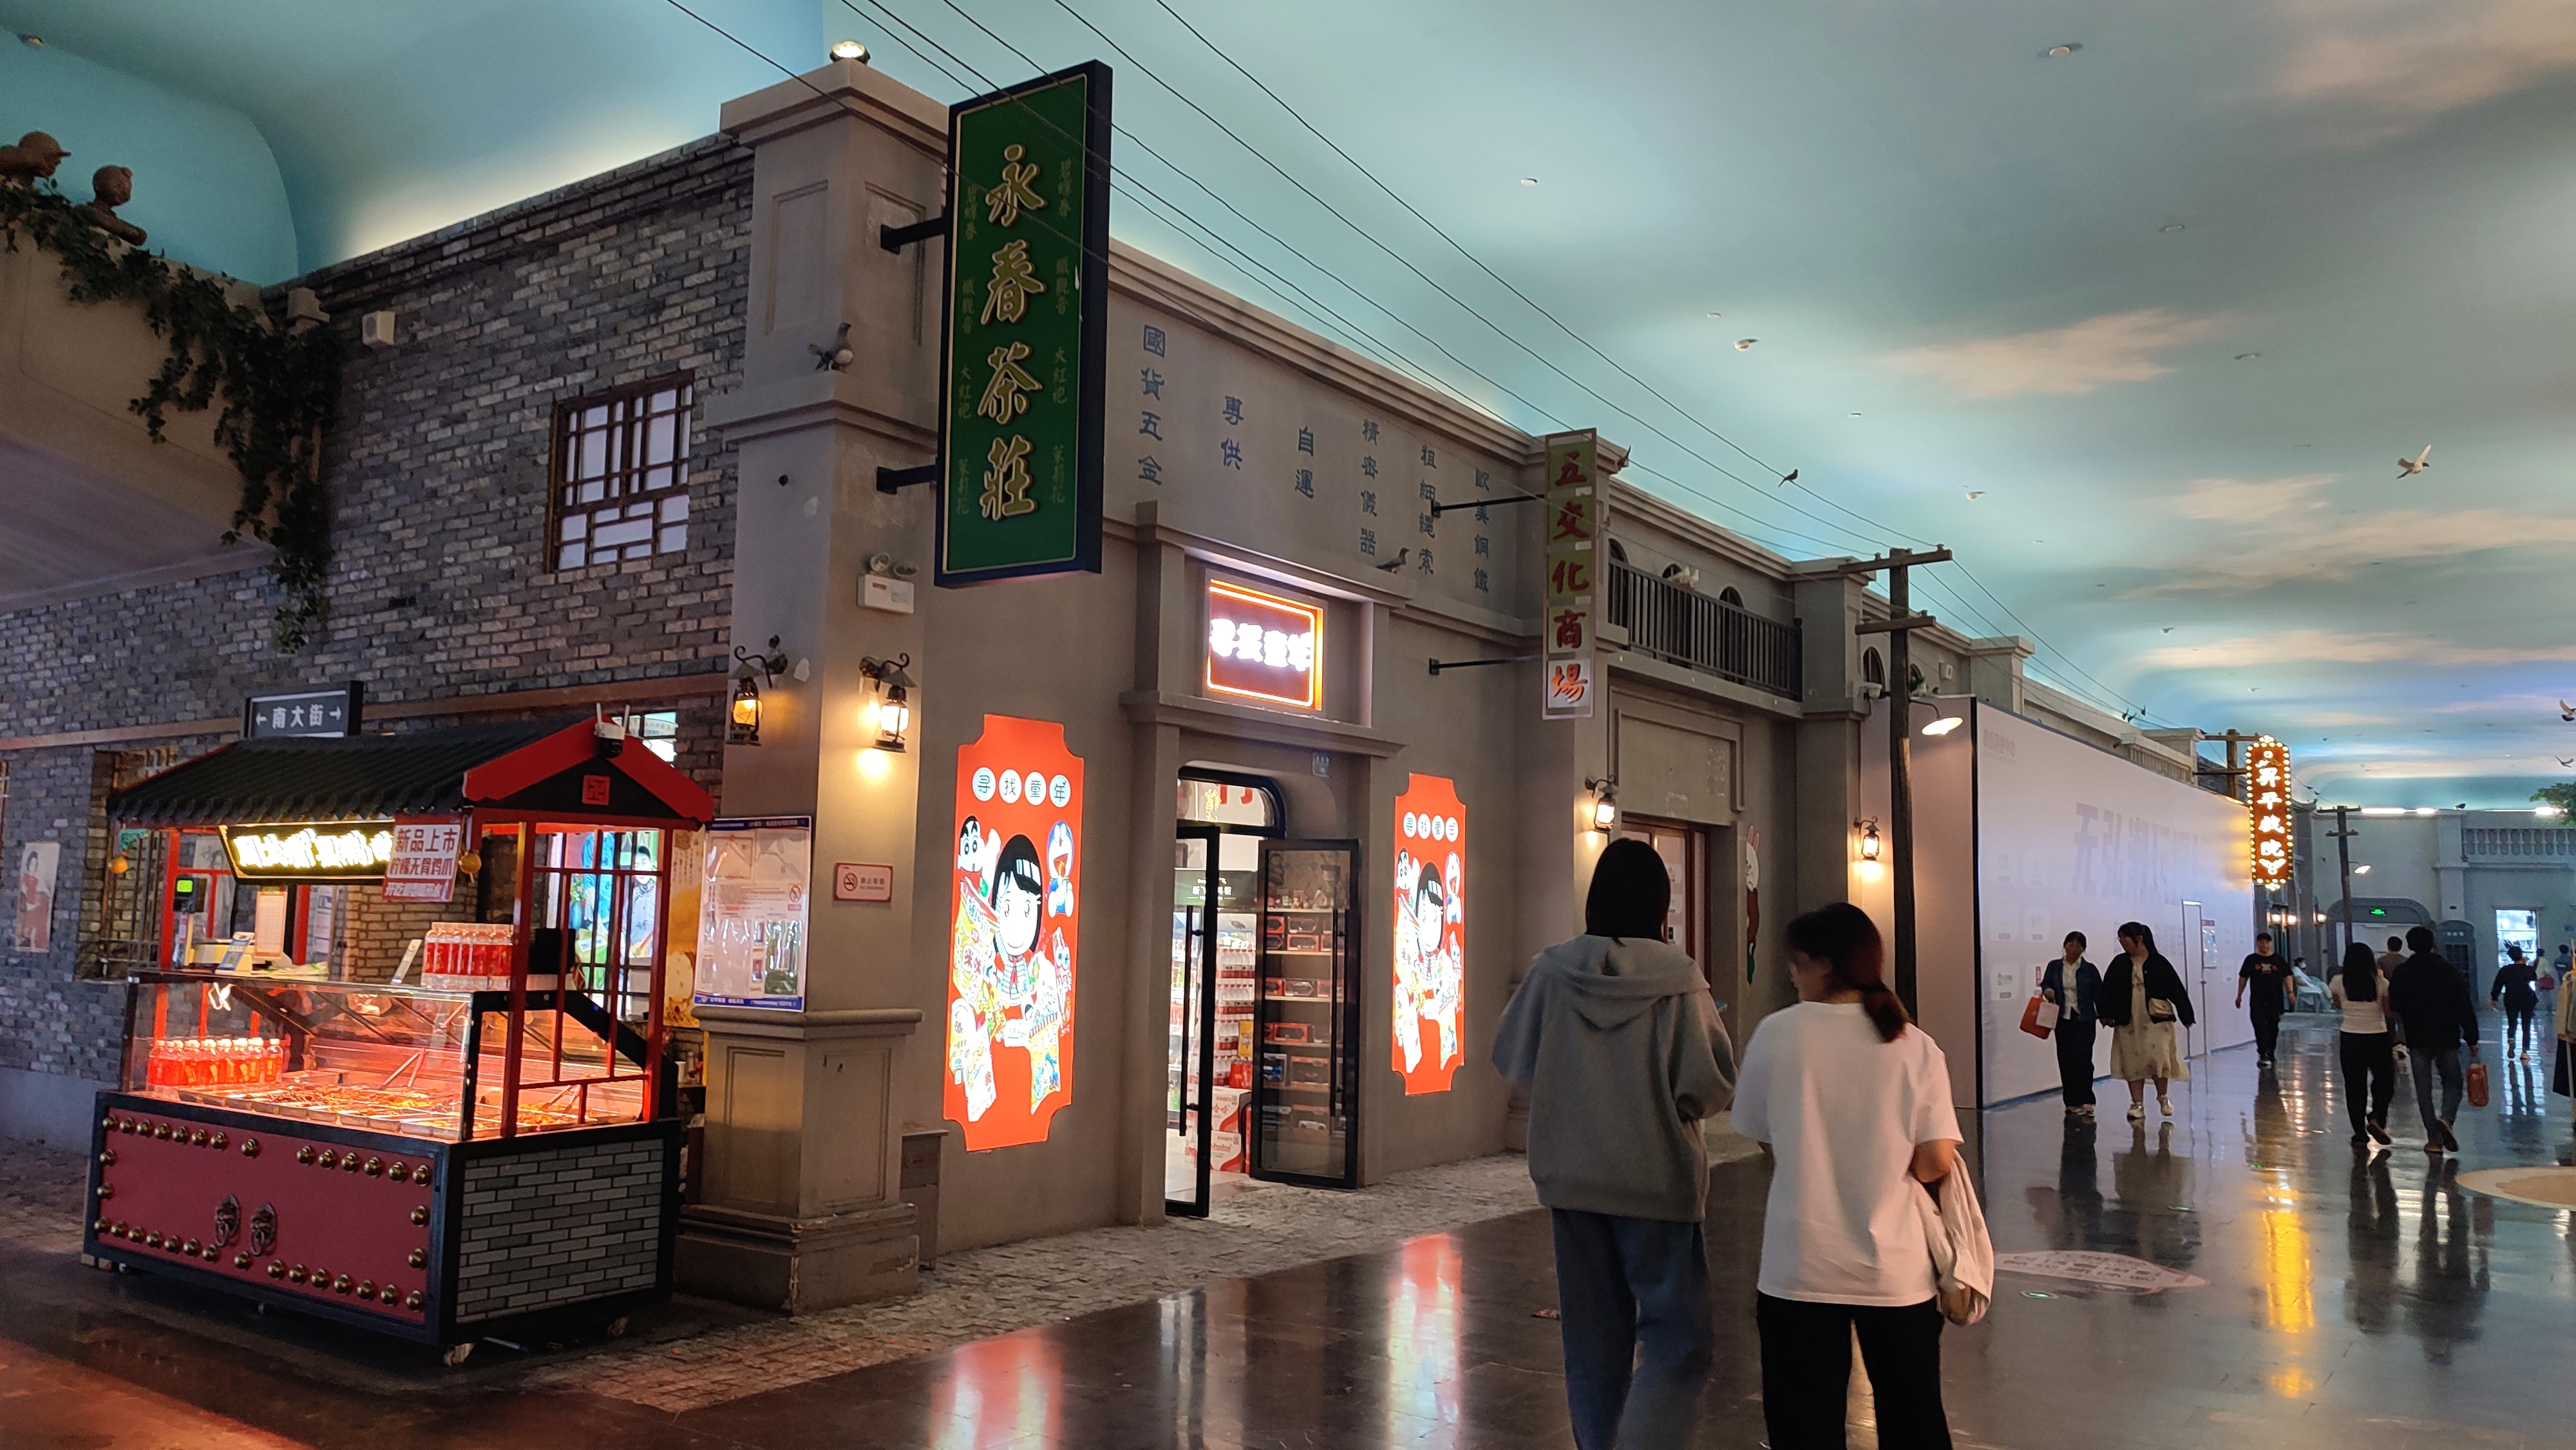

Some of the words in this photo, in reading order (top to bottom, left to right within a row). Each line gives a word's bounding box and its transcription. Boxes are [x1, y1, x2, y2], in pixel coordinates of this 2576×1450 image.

[1137, 325, 1166, 485] 國貨五金
[1294, 426, 1315, 499] 自運
[1359, 419, 1380, 557] 精密儀器
[1551, 452, 1589, 704] 五交化商場
[272, 704, 324, 730] 南大街
[395, 828, 458, 853] 新品上市
